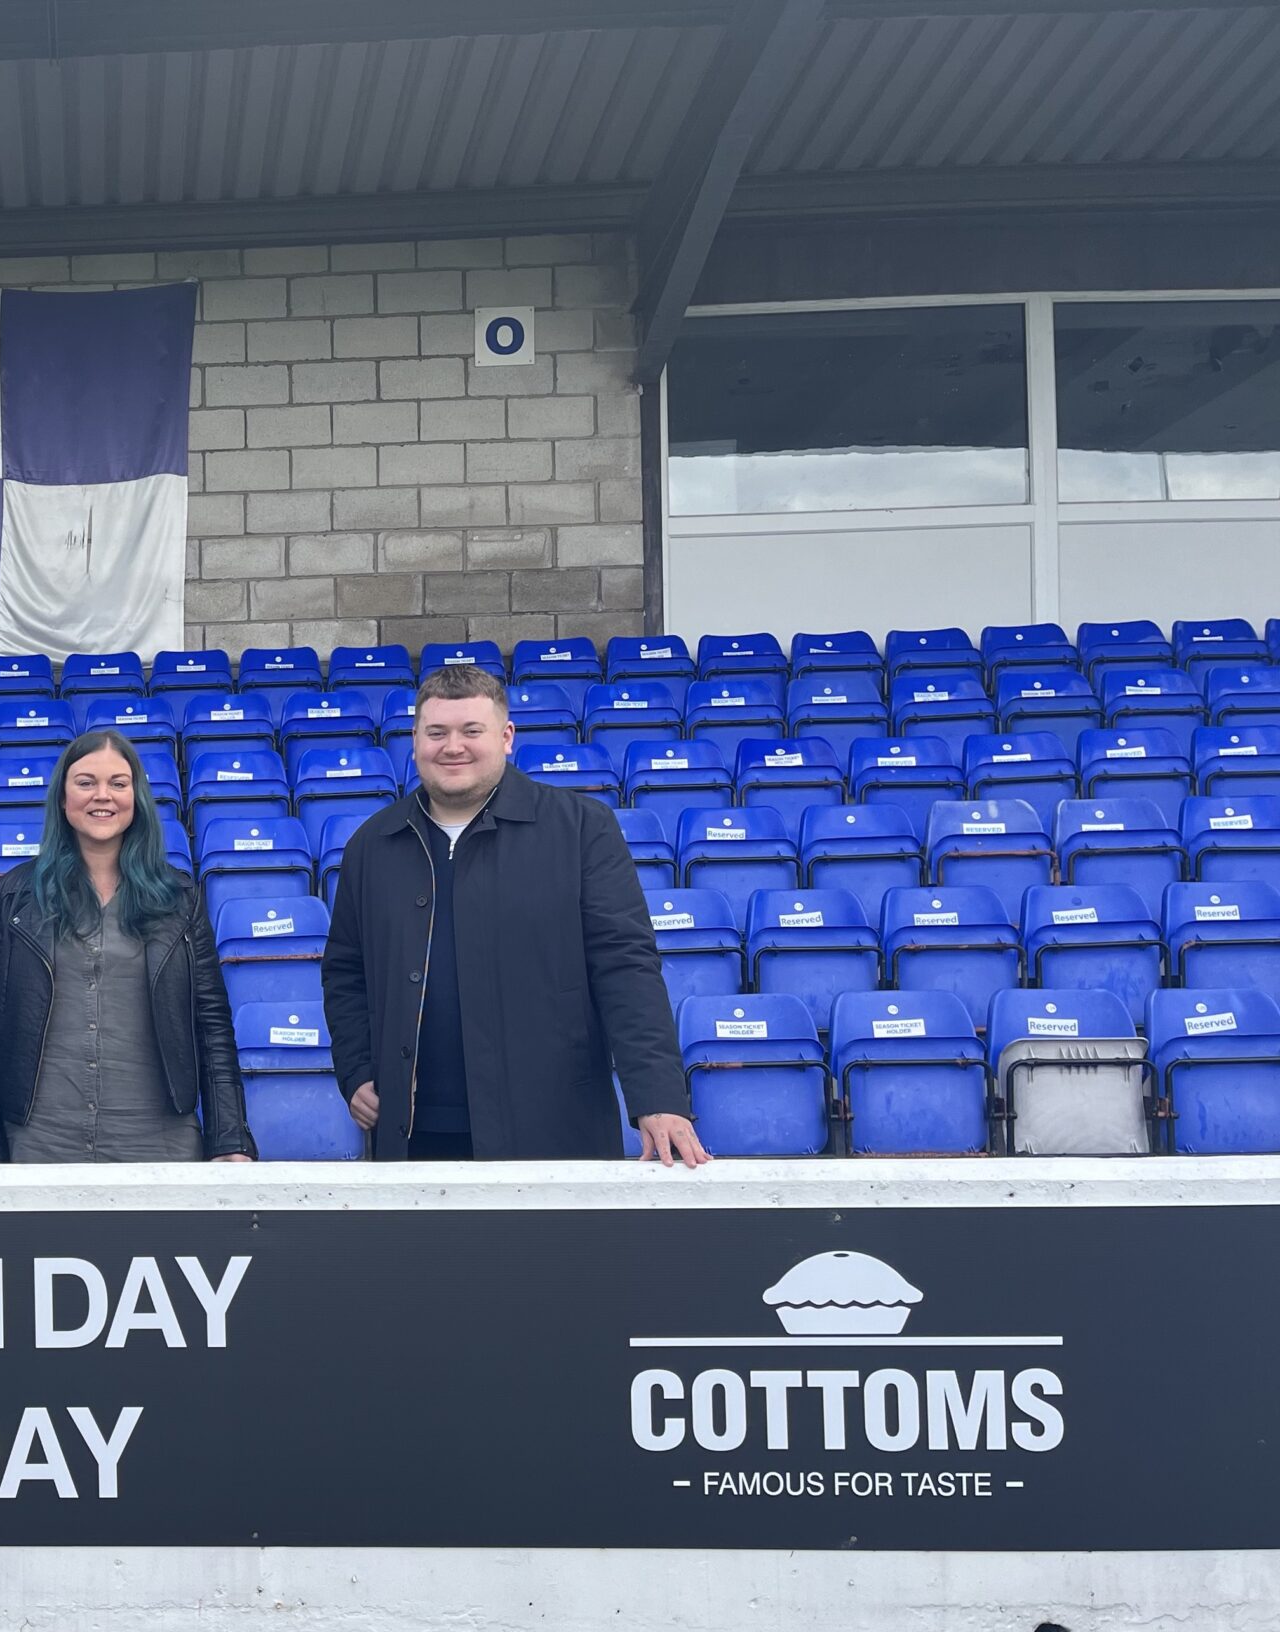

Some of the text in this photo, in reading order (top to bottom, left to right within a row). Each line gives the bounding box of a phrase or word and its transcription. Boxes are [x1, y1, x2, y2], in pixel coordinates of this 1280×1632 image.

[708, 830, 744, 839] Reserved
[1055, 911, 1095, 922] Reserved
[1196, 907, 1237, 918] Reserved
[653, 916, 693, 927] Reserved
[782, 914, 821, 926] Reserved
[916, 916, 957, 926] Reserved
[254, 922, 292, 933] Reserved
[1029, 1021, 1076, 1032] Reserved
[1187, 1015, 1233, 1031] Reserved
[34, 1256, 253, 1348] DAY
[631, 1368, 1064, 1452] COTTOMS
[704, 1472, 992, 1496] FAMOUS FOR TASTE
